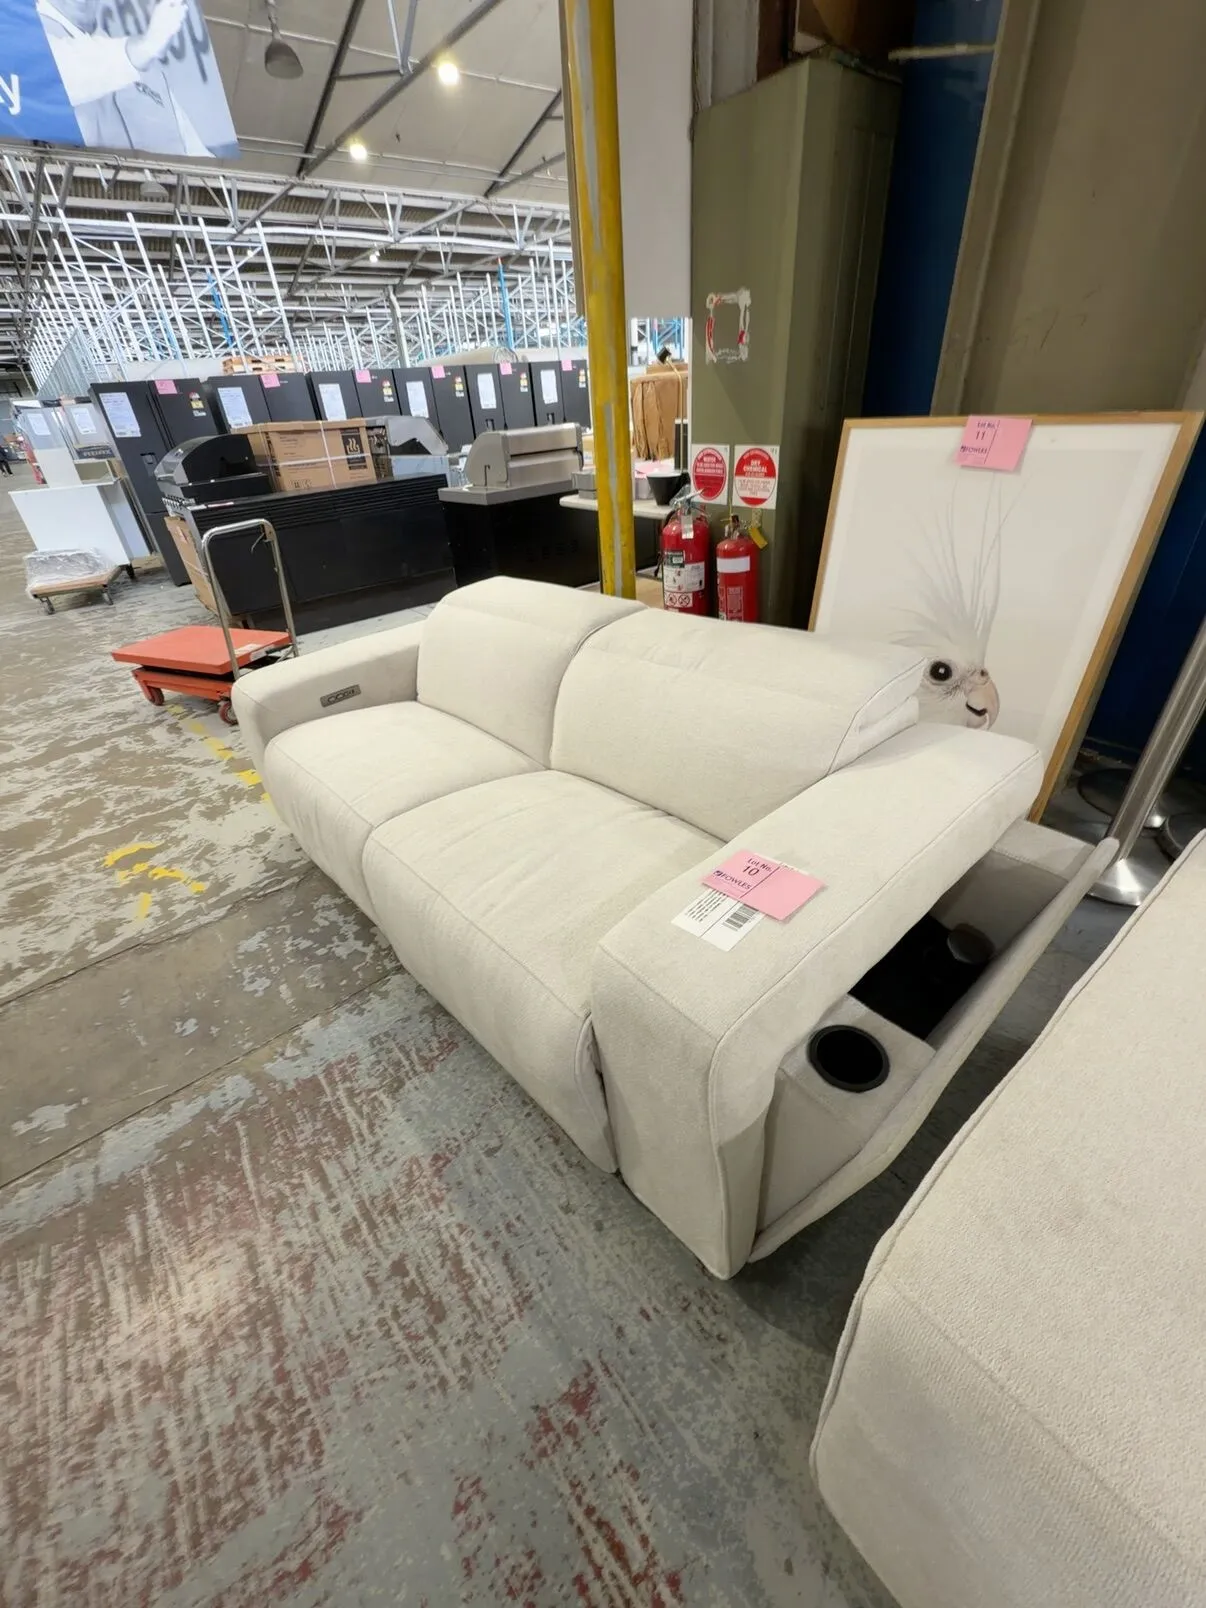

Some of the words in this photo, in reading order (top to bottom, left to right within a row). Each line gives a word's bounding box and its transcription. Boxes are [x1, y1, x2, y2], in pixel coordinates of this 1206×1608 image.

[976, 431, 986, 440] 11
[742, 865, 760, 876] 10
[747, 858, 760, 867] Lot
[760, 863, 772, 872] No.
[722, 873, 752, 890] FOWLES
